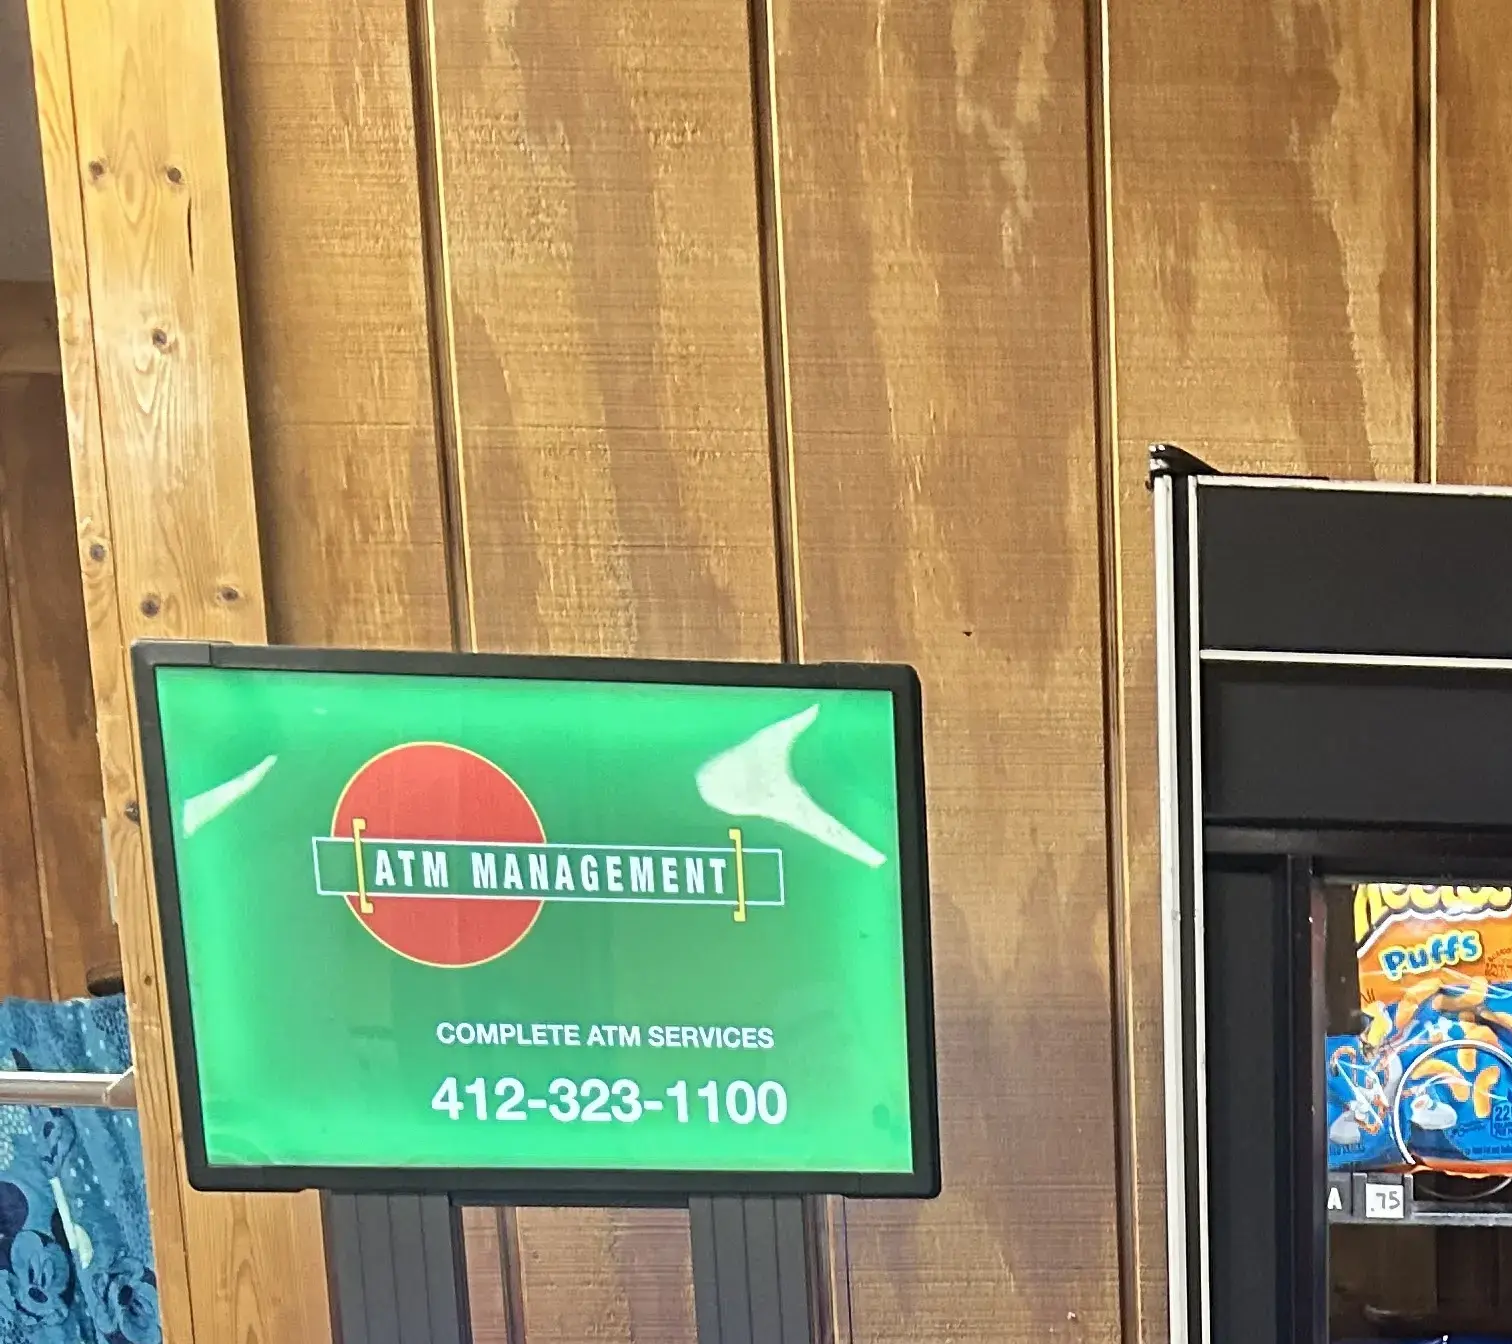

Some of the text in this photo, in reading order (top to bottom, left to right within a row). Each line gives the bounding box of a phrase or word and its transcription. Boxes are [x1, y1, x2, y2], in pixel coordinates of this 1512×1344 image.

[374, 850, 728, 896] ATM MANAGEMENT
[1382, 932, 1480, 974] Puffs
[436, 1022, 774, 1049] COMPLETE ATM SERVICES
[431, 1077, 788, 1126] 412-323-1100
[1327, 1187, 1342, 1210] A
